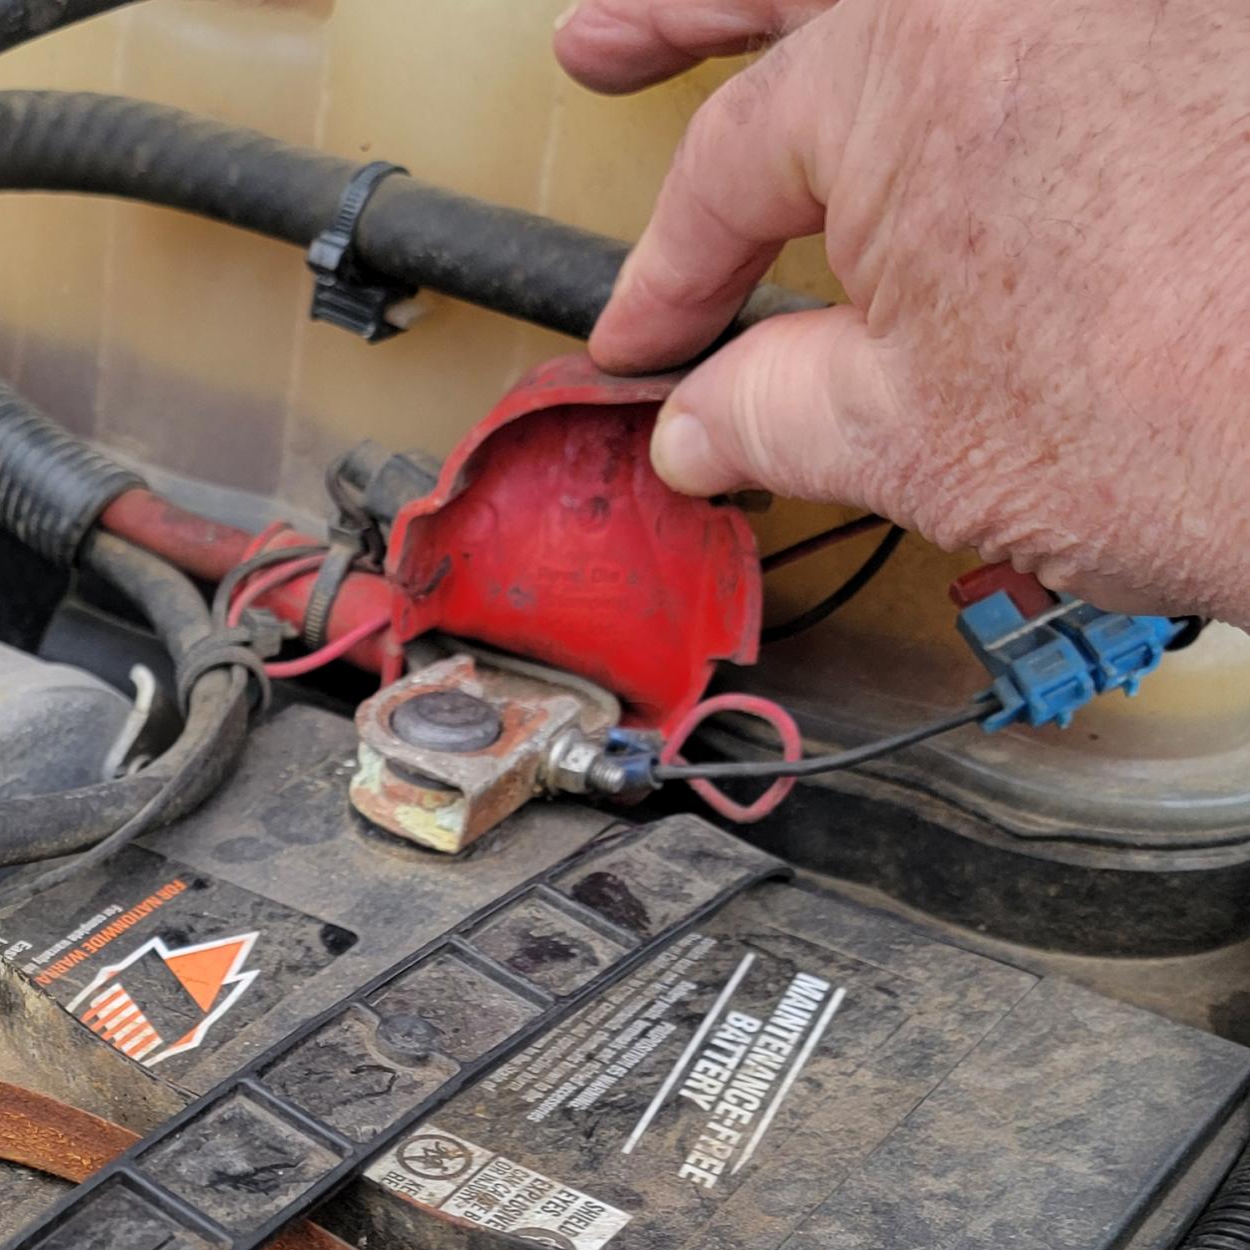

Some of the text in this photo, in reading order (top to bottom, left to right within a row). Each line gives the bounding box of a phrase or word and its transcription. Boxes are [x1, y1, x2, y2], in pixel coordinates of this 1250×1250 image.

[155, 879, 186, 901] FOR
[81, 894, 163, 955] NATIONWIDE
[678, 1009, 762, 1110] BATTERY
[677, 970, 830, 1189] MAINTENANCE-FREE
[488, 1160, 511, 1176] OR
[470, 1182, 511, 1215] CAUSE
[484, 1177, 553, 1231] EXPLOSIVE
[534, 1189, 579, 1218] EYES.
[556, 1199, 606, 1238] SHIELD
